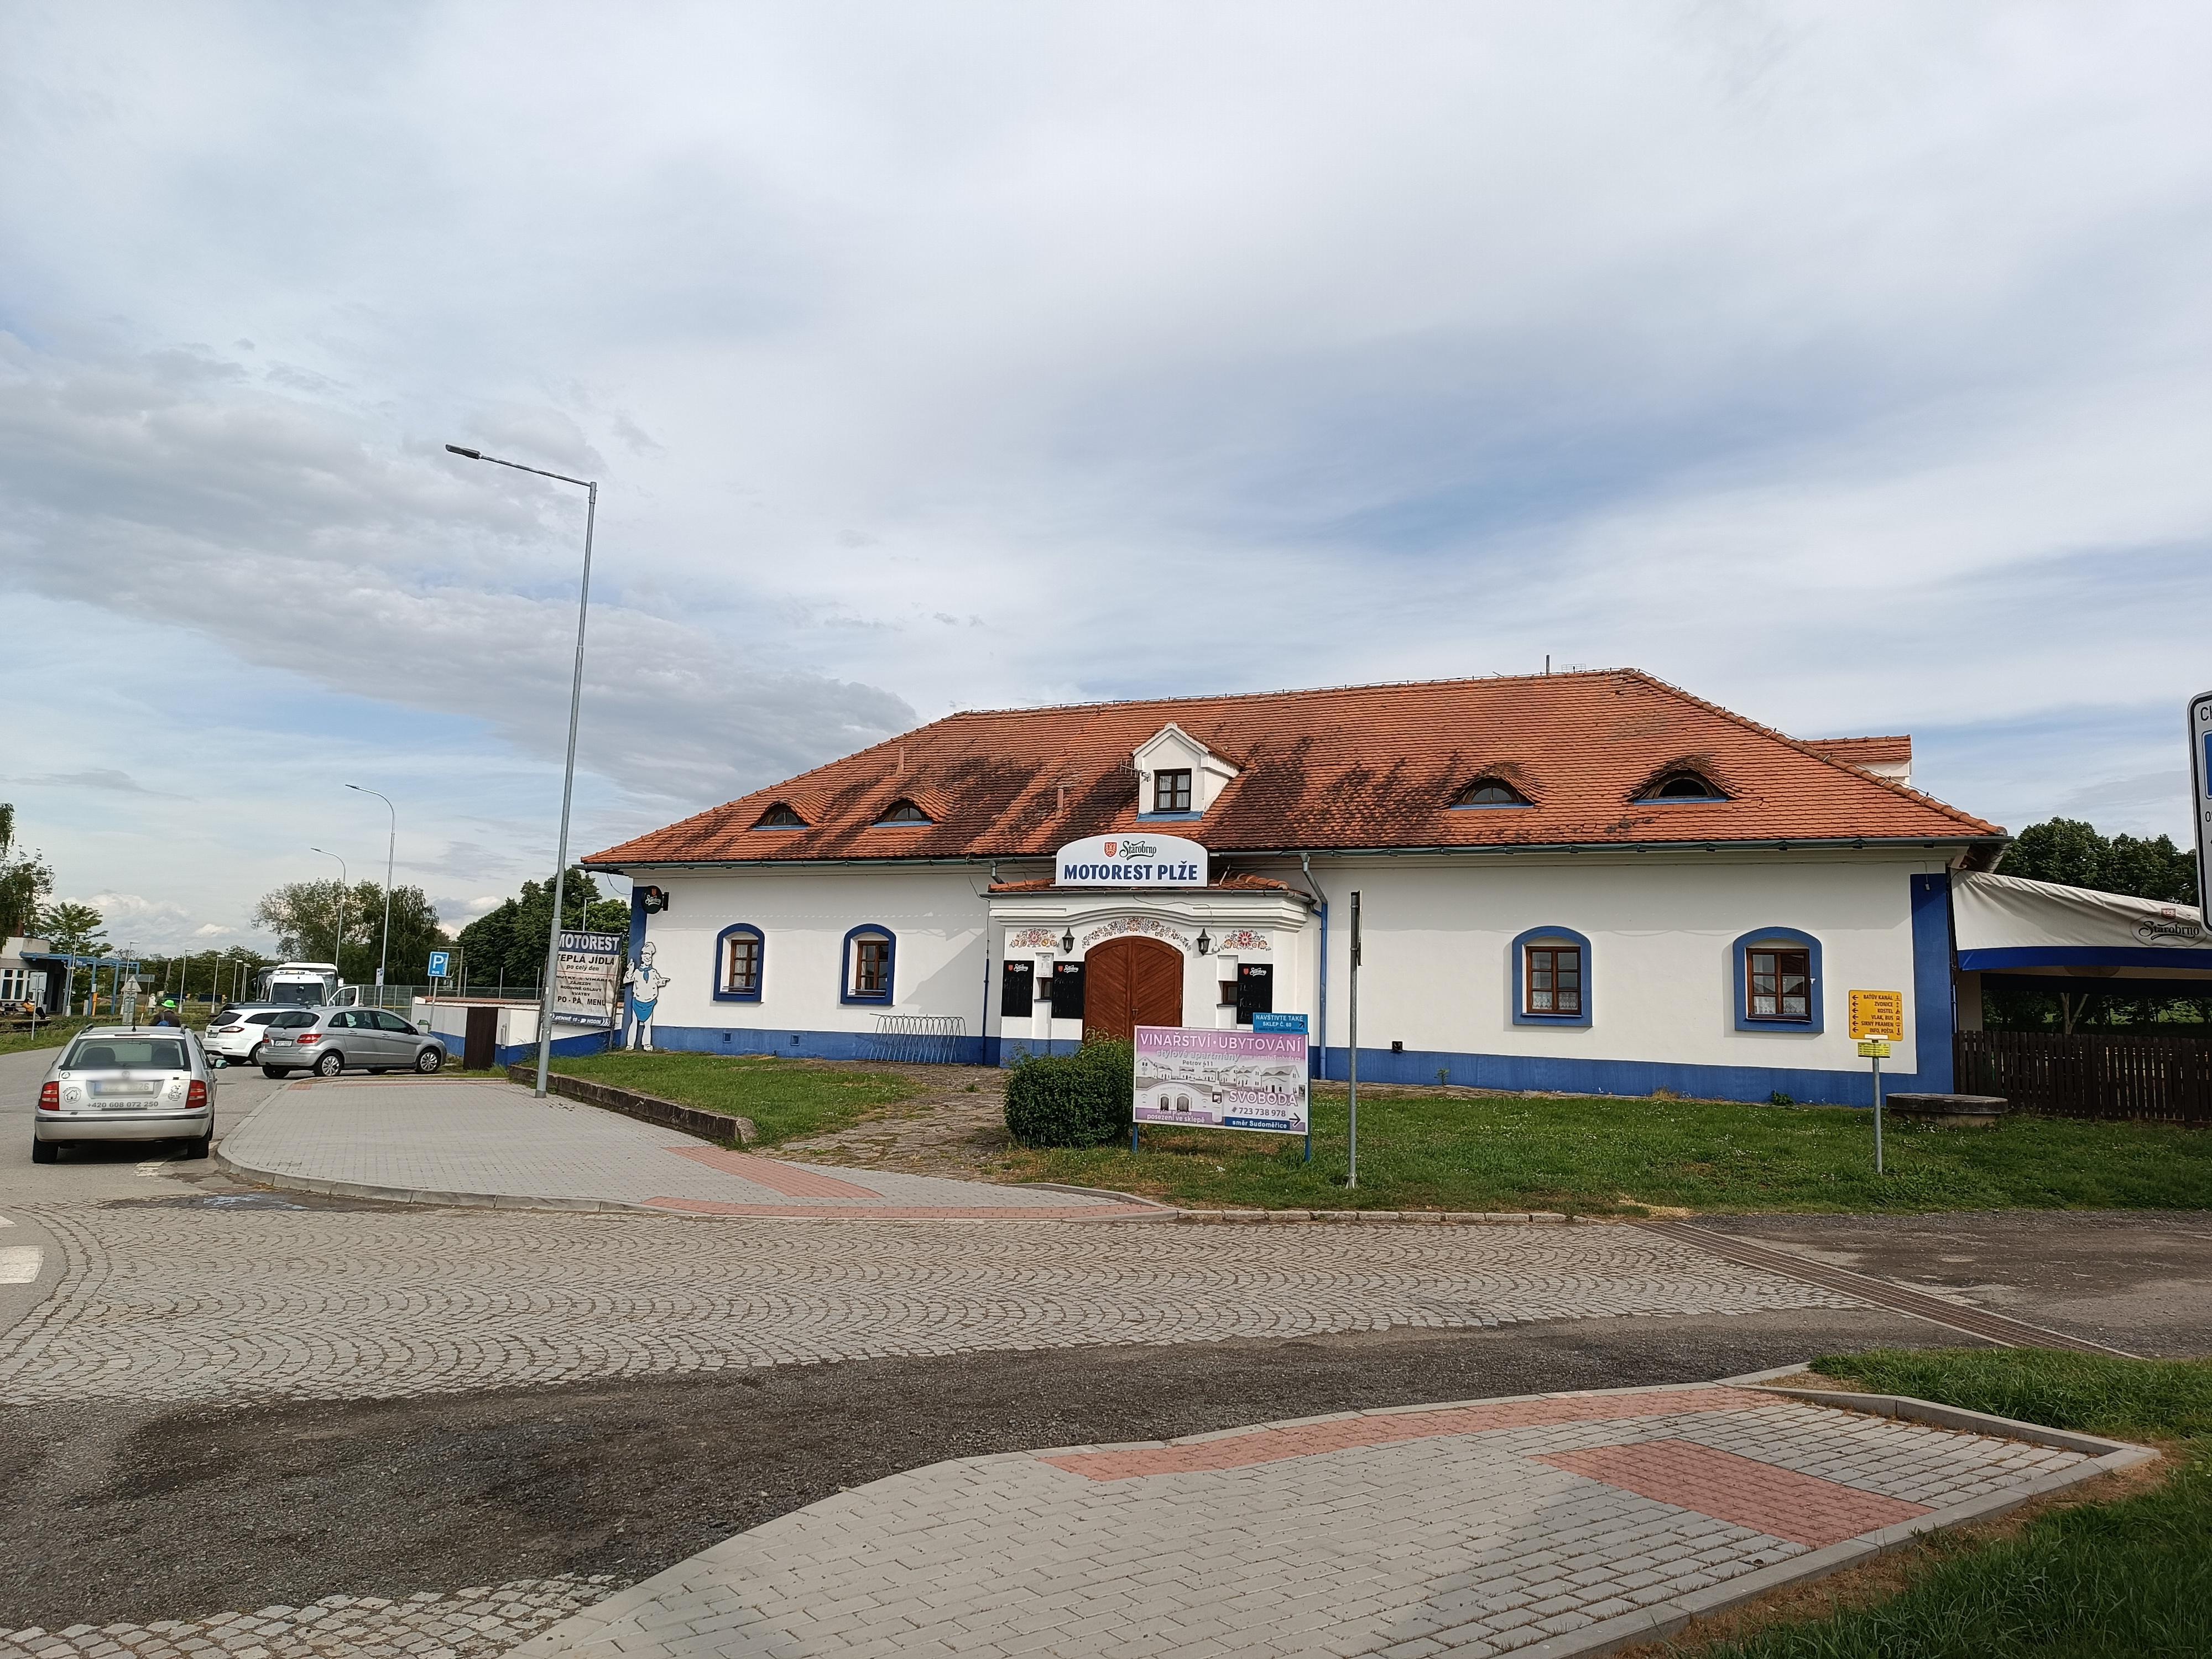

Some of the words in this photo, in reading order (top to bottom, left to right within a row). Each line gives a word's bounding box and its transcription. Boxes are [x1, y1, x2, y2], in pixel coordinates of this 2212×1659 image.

[1119, 841, 1156, 860] Starobrno
[1064, 864, 1152, 880] MOTOREST
[1157, 860, 1197, 880] PLŽE
[2138, 921, 2199, 940] Starobrno
[433, 955, 444, 968] P
[588, 955, 614, 965] JÍDLA
[1140, 1032, 1212, 1048] VINAŘSTVÍ
[1219, 1034, 1301, 1052] UBYTOVÁNÍ
[1156, 1049, 1188, 1058] stylové
[1190, 1051, 1239, 1062] apartmány
[1229, 1090, 1298, 1107] SVOBODA
[1249, 1120, 1287, 1129] Sudoměřice
